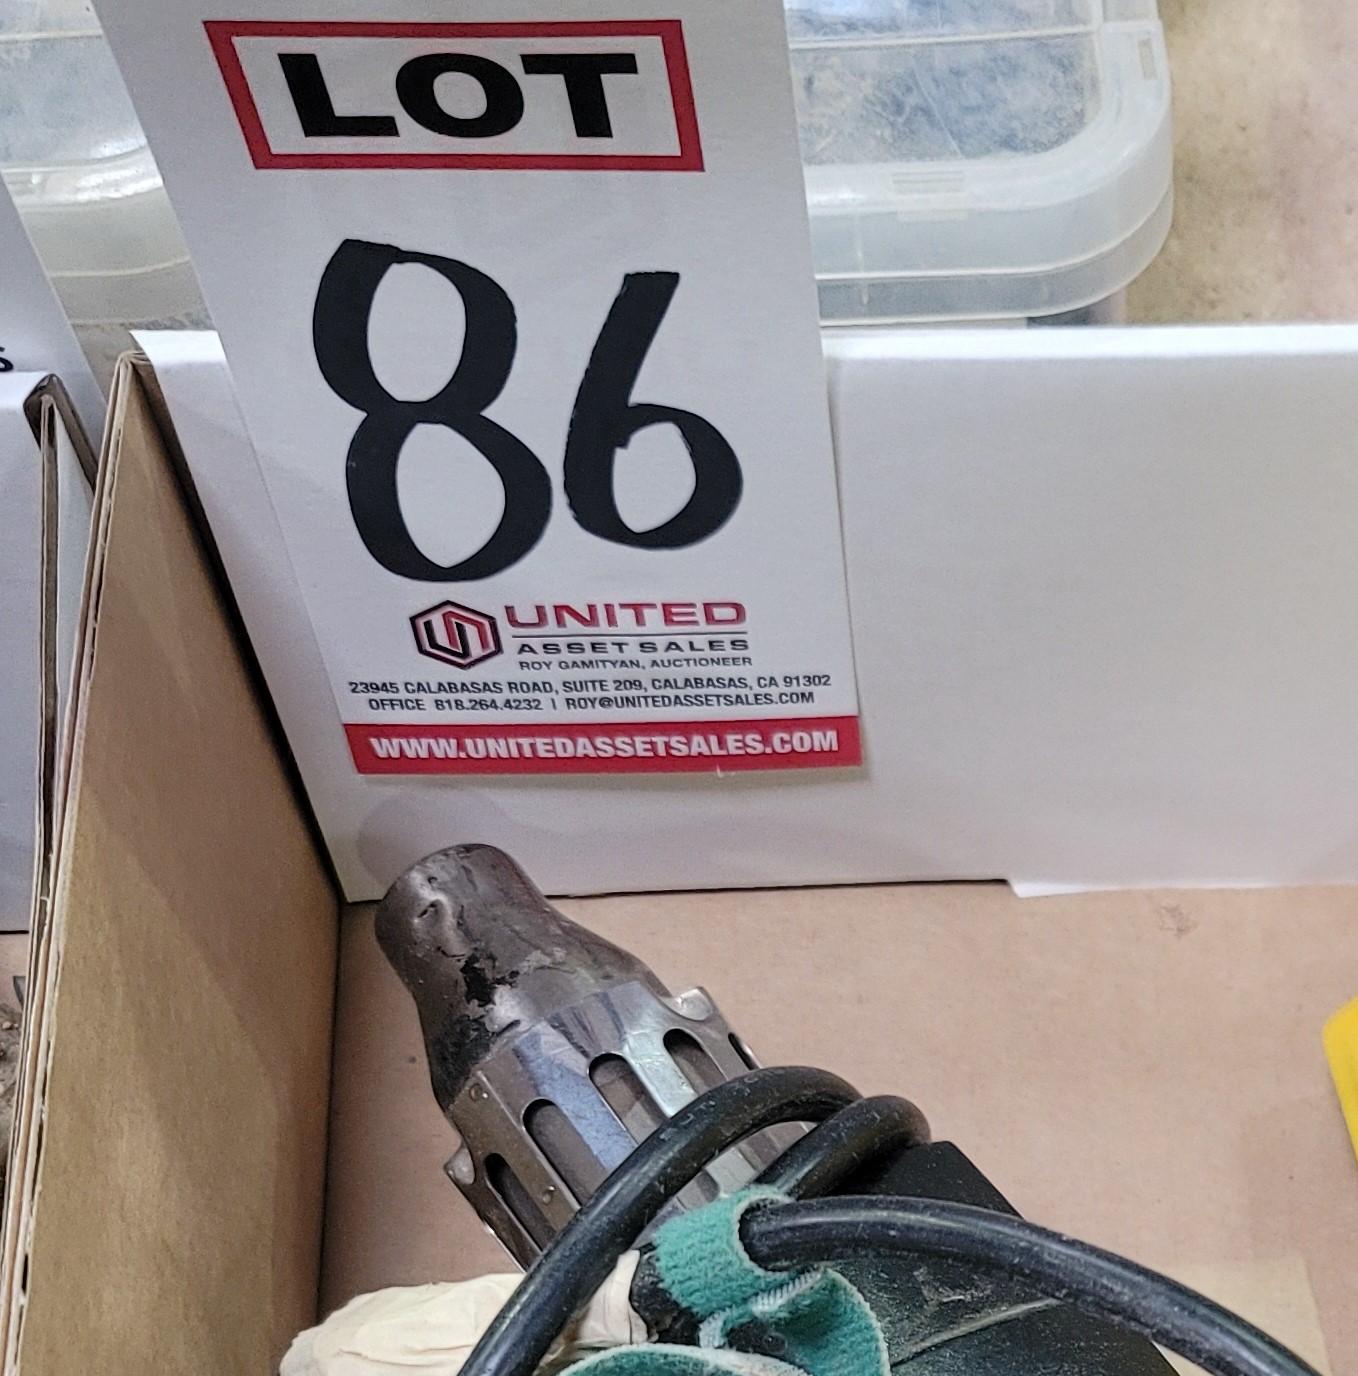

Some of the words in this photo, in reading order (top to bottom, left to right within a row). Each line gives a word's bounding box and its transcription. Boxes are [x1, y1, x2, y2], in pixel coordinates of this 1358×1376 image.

[278, 53, 638, 138] LOT
[312, 238, 744, 583] 86
[504, 602, 747, 628] UNITED
[517, 641, 630, 655] ASSET
[639, 639, 749, 653] SALES
[519, 660, 552, 671] ROY
[558, 659, 647, 671] GAMITYAN,
[650, 657, 753, 668] AUCTIONEER
[349, 681, 400, 694] 23945
[404, 680, 503, 694] CALABASAS
[508, 680, 559, 696] ROAD,
[562, 679, 609, 693] SUITE
[613, 678, 648, 693] 209,
[651, 676, 753, 692] CALABASAS,
[757, 676, 780, 689] CA
[783, 674, 832, 687] 91302
[369, 698, 426, 711] OFFICE
[434, 698, 544, 711] 818.264.4232
[565, 692, 816, 710] ROY@UNITEDASSETSALES.COM
[370, 730, 840, 760] WWW.UNITEDASSETSALES.COM
